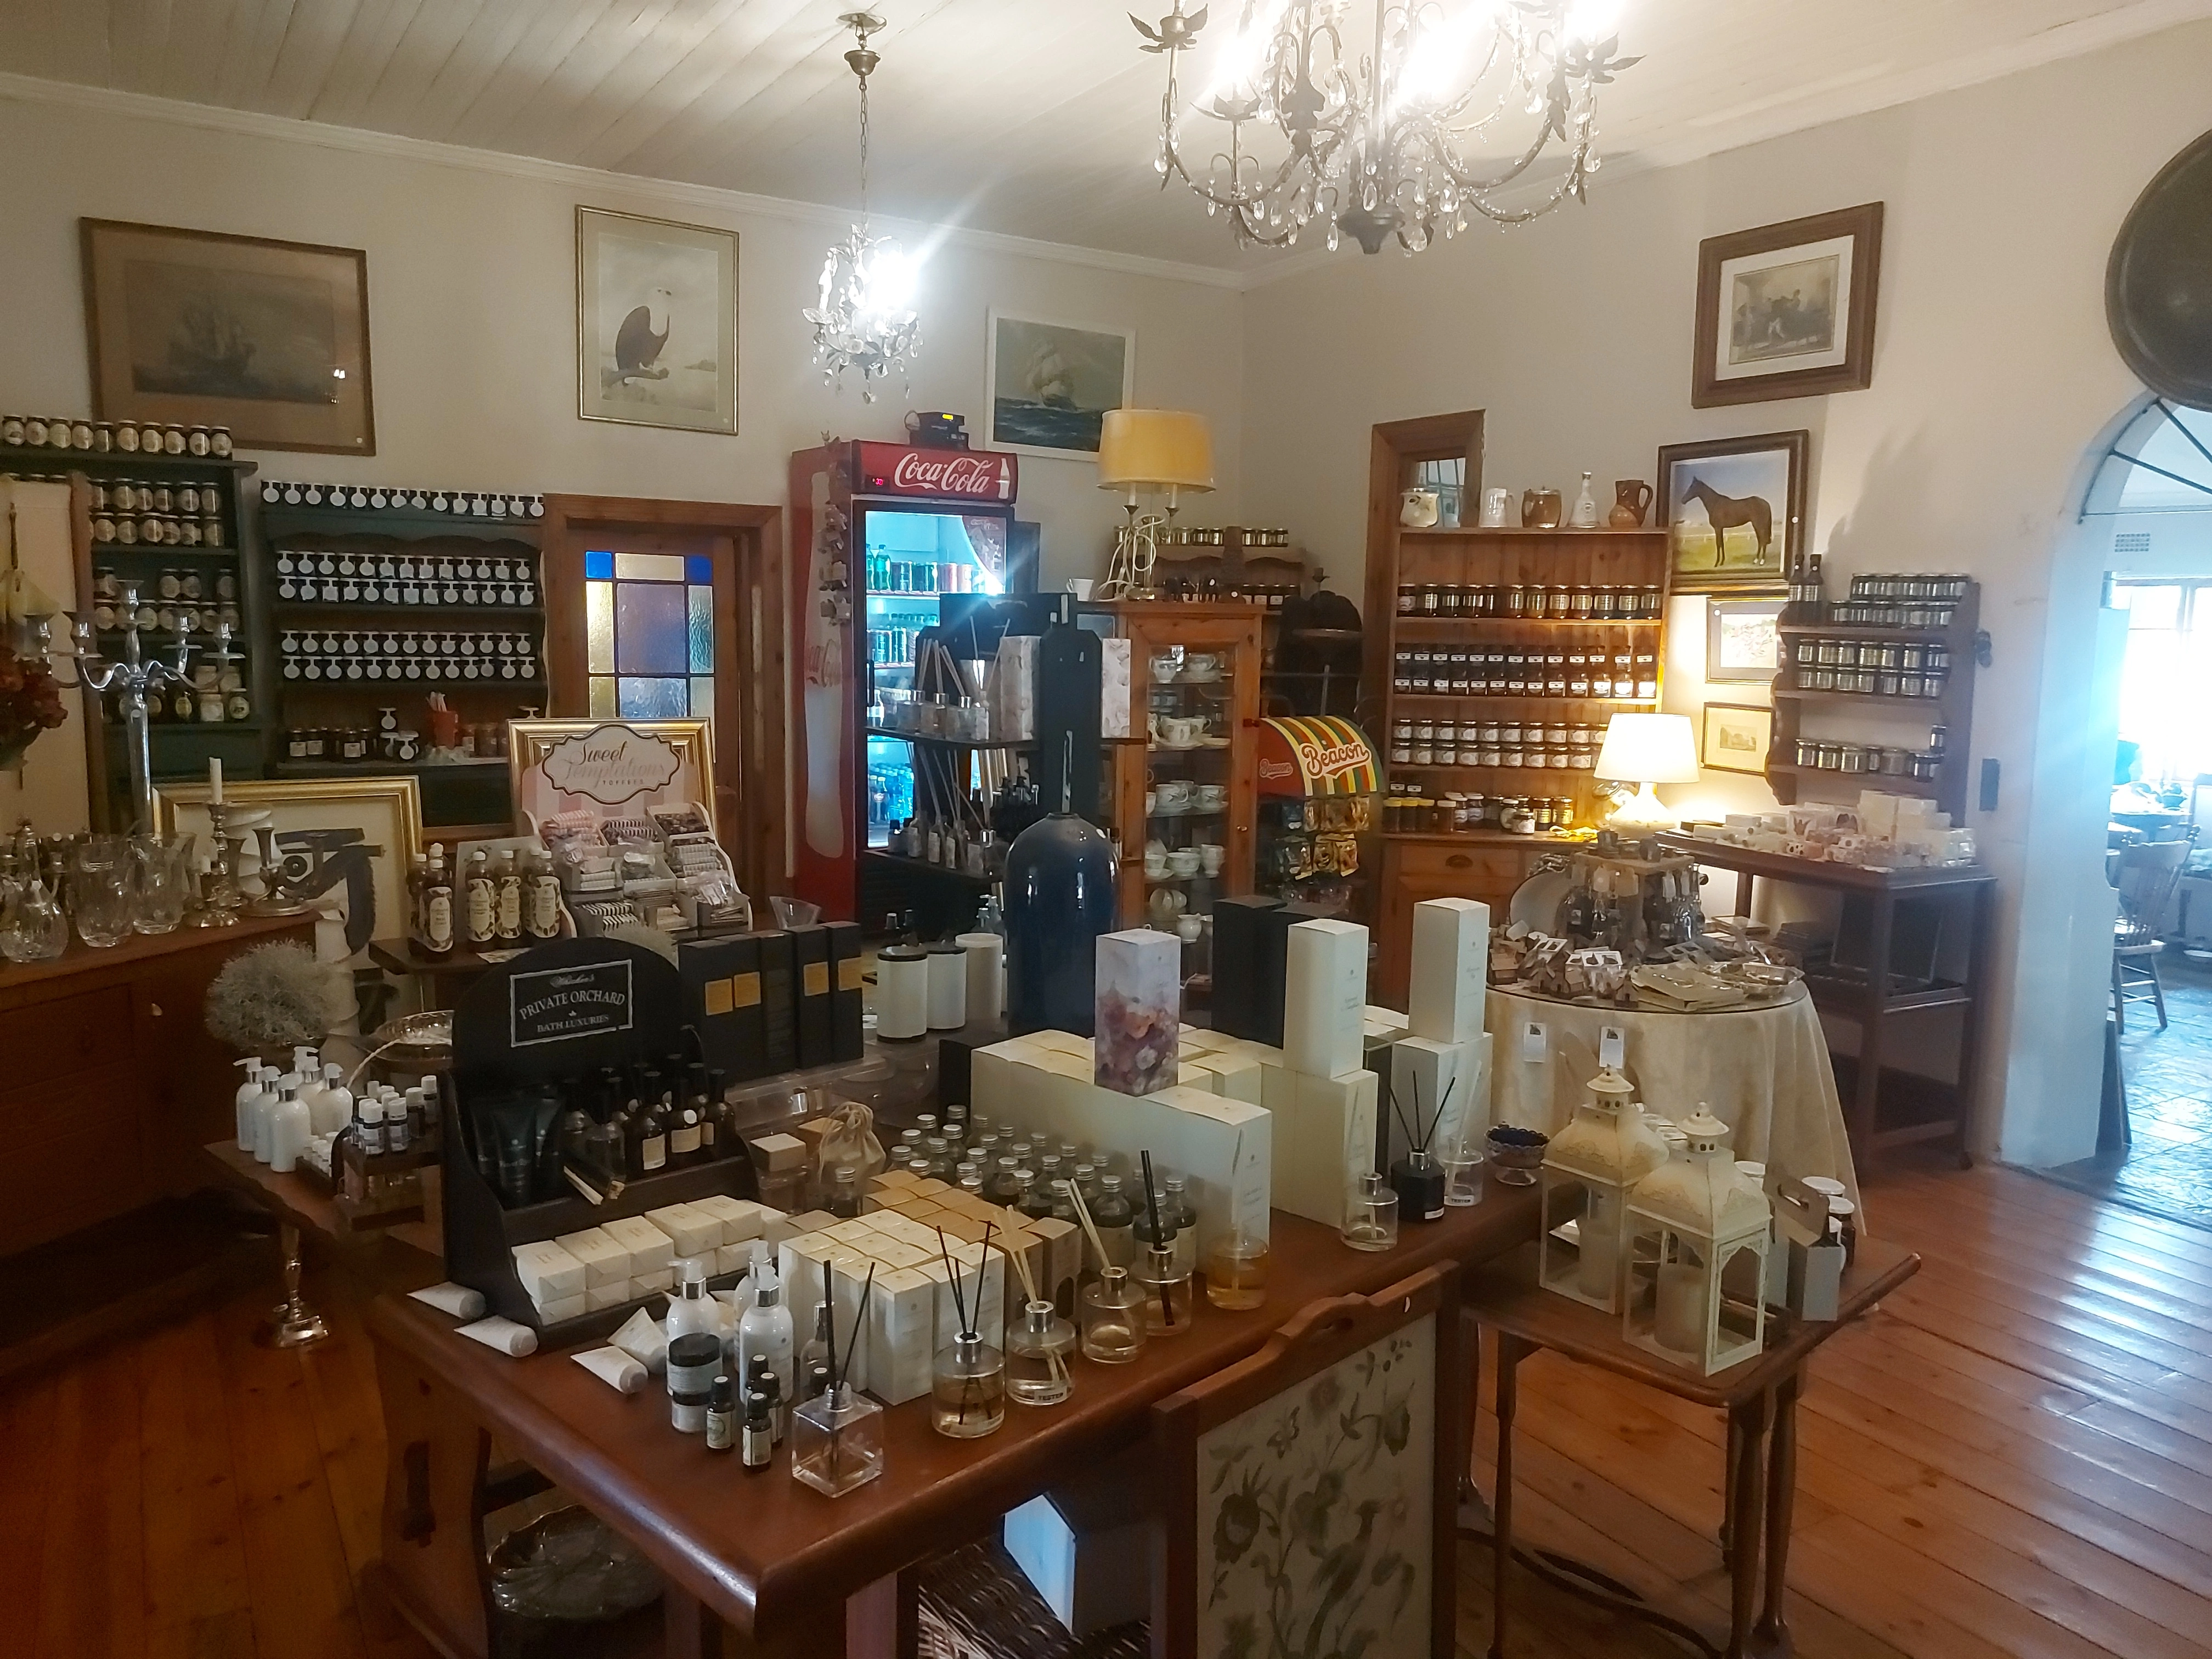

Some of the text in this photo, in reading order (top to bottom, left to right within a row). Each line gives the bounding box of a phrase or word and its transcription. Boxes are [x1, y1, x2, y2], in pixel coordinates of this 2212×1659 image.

[894, 453, 994, 493] Coca-Cola
[571, 741, 630, 765] Sweet
[1260, 759, 1293, 777] Beacon
[1301, 743, 1370, 776] Beacon
[559, 757, 664, 789] Temptations
[519, 990, 625, 1020] PRIVATE ORCHARD
[537, 1014, 610, 1032] BATH LUXURIES
